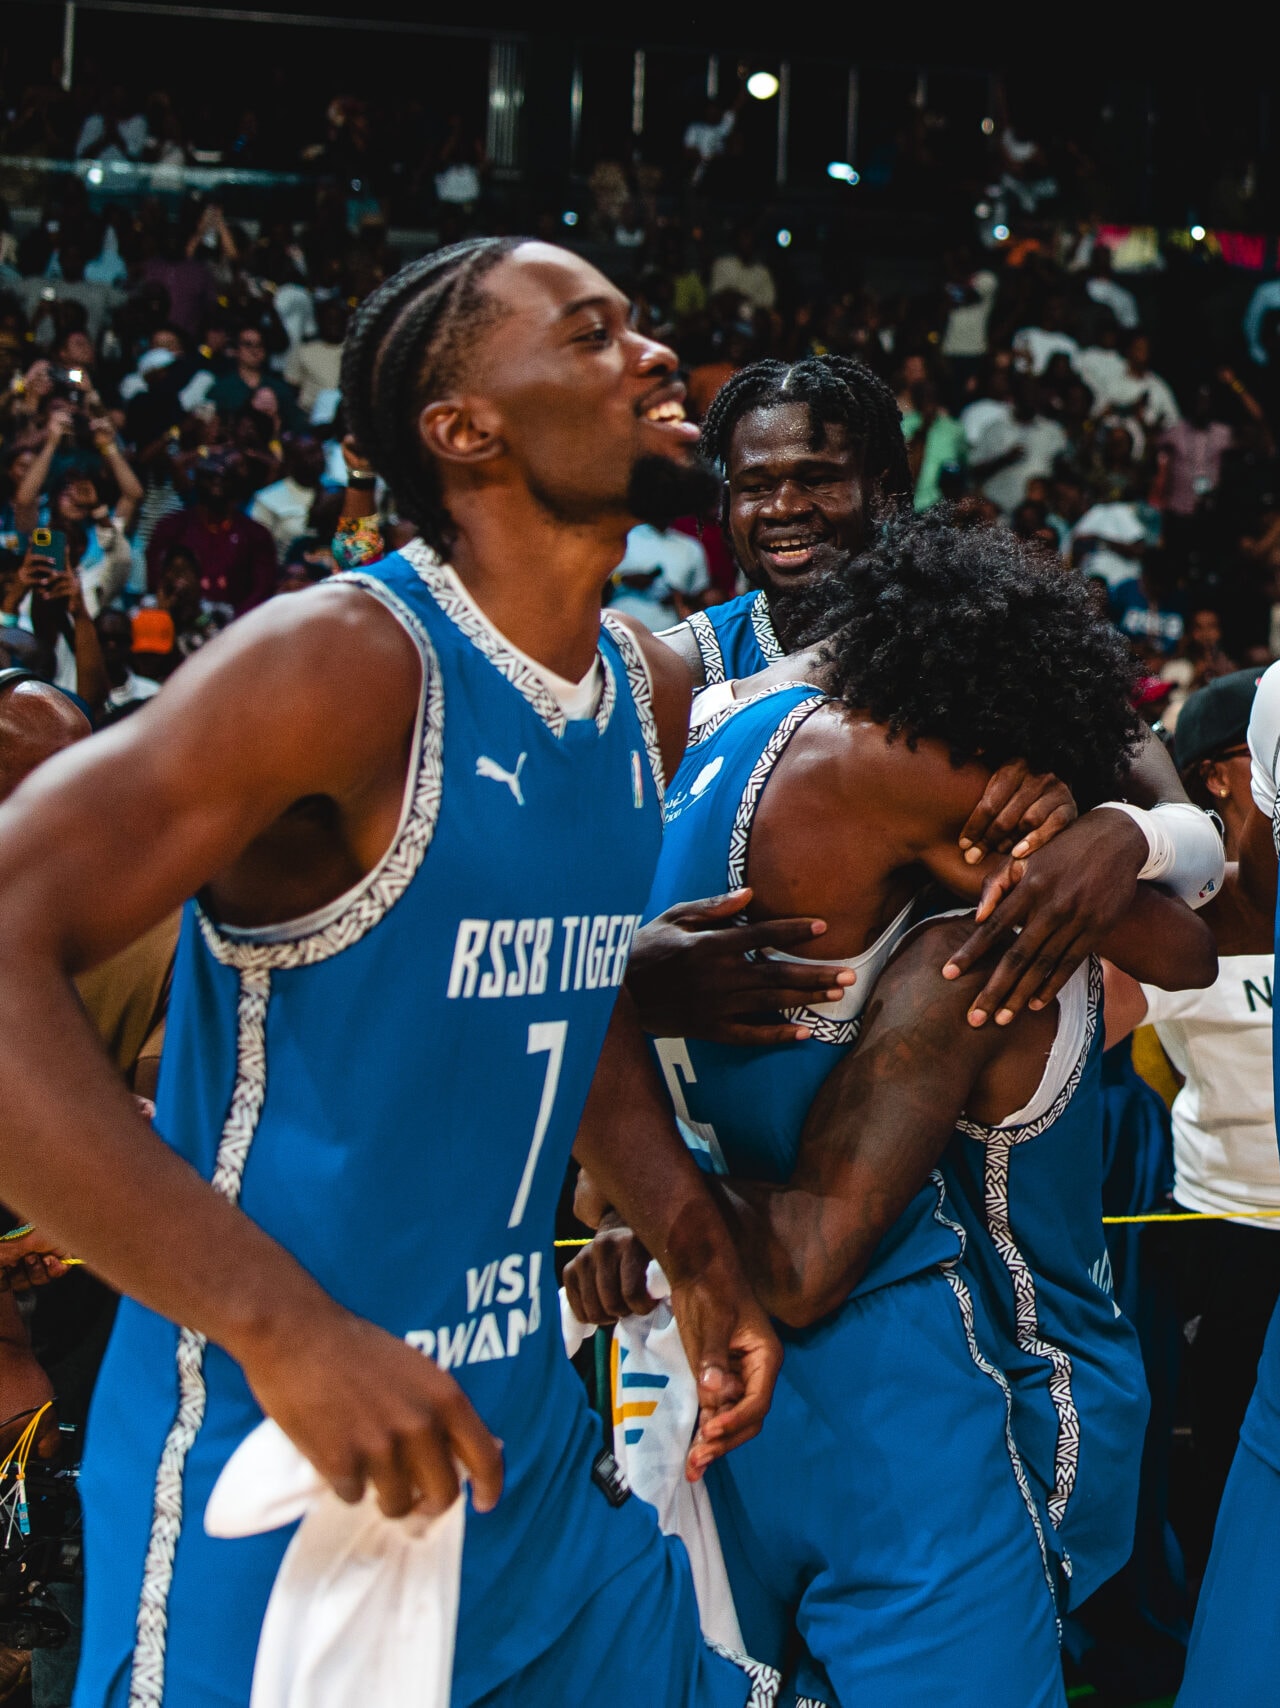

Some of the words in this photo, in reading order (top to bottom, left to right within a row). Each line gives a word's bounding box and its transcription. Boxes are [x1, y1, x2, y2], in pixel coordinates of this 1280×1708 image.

[446, 918, 554, 999] RSSB
[559, 914, 643, 992] TIGER
[507, 1020, 568, 1229] 7
